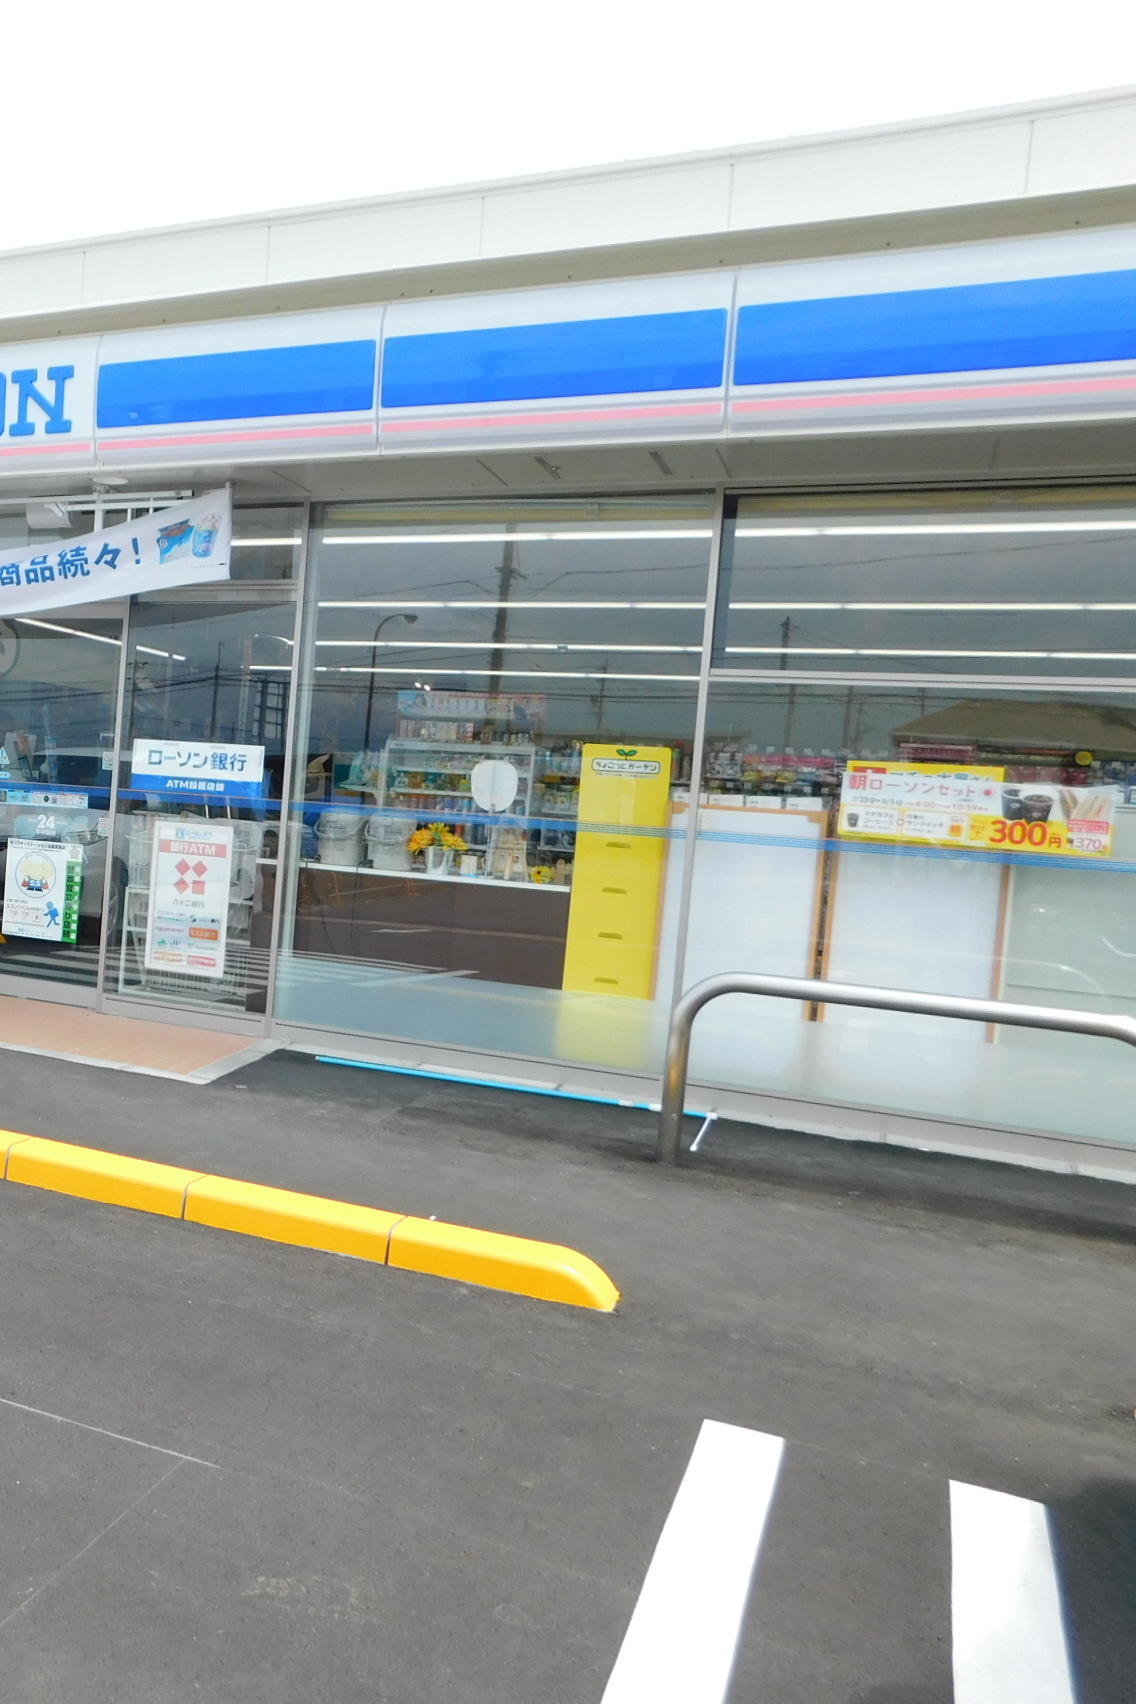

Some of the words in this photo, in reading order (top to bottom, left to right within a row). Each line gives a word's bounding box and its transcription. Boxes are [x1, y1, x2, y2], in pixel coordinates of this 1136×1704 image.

[148, 749, 247, 772] ローソン銀行
[849, 775, 976, 797] 朝ローソンセット
[36, 814, 55, 829] 24
[989, 819, 1047, 846] 300
